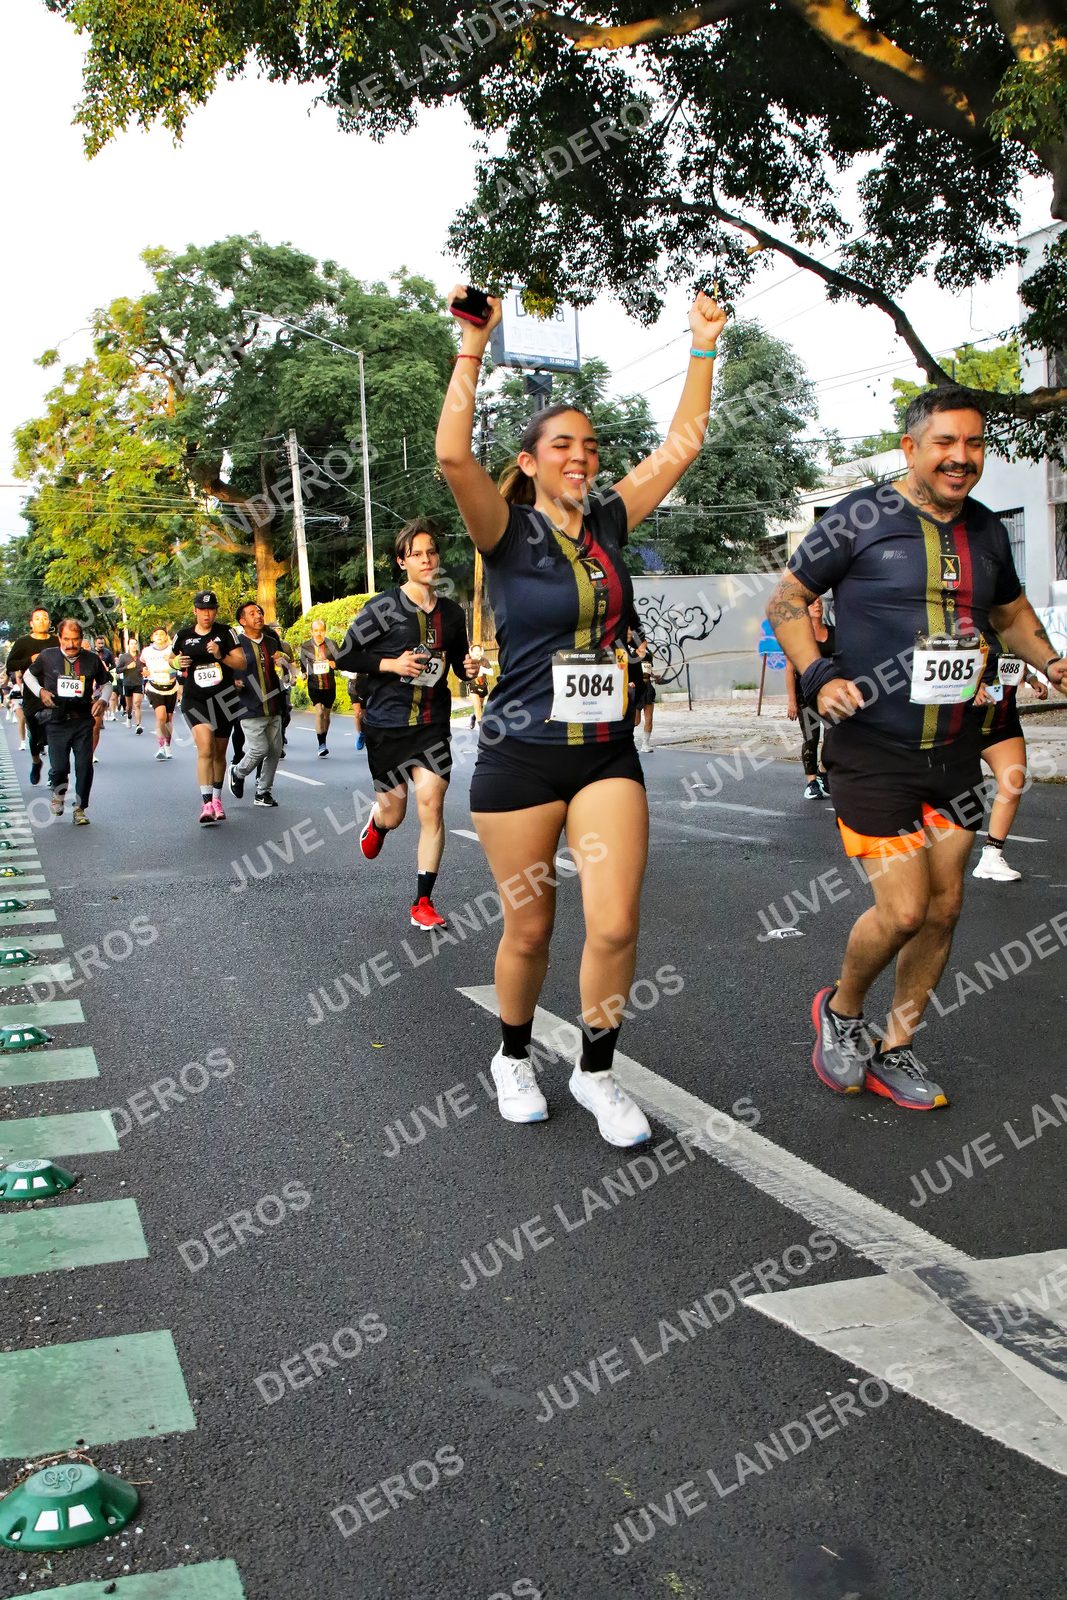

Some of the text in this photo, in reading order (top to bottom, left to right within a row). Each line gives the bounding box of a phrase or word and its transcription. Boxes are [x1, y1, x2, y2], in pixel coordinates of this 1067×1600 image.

[425, 662, 439, 675] 82
[924, 658, 975, 681] 5085
[1000, 662, 1020, 674] 4888
[198, 670, 217, 681] 5362
[60, 681, 80, 690] 4768
[565, 673, 614, 698] 5084
